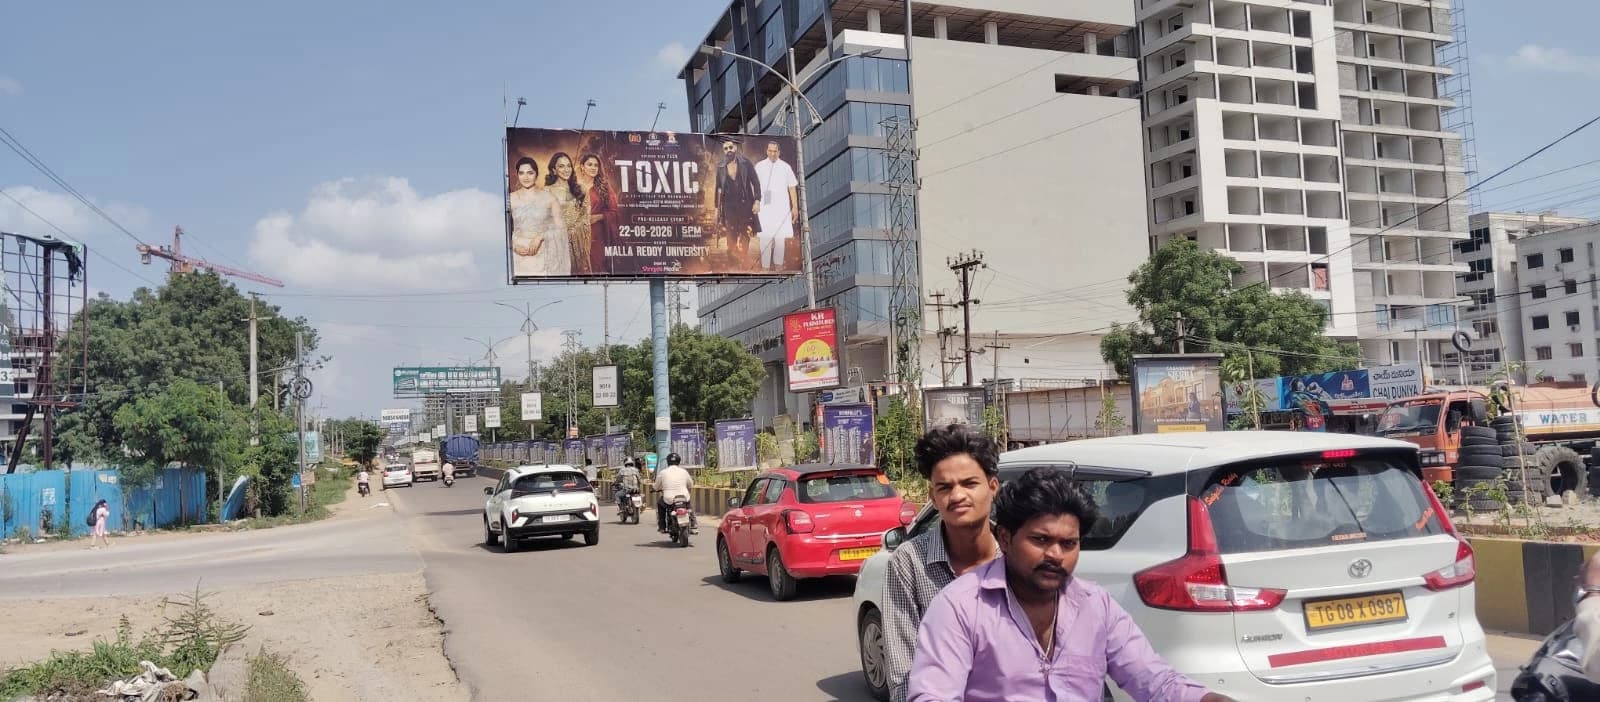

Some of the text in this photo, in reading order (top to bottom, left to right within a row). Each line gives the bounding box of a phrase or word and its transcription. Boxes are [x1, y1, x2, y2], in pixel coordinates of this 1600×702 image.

[615, 160, 699, 194] TOXIC
[618, 225, 703, 238] 22-08-2026 5PM
[604, 246, 711, 257] MALLA REDDY UNIVERSITY
[1372, 386, 1391, 401] CHAI
[1391, 383, 1419, 400] DUNIYA
[1539, 413, 1587, 424] WATER
[1314, 597, 1402, 624] TG 08 X 0987
